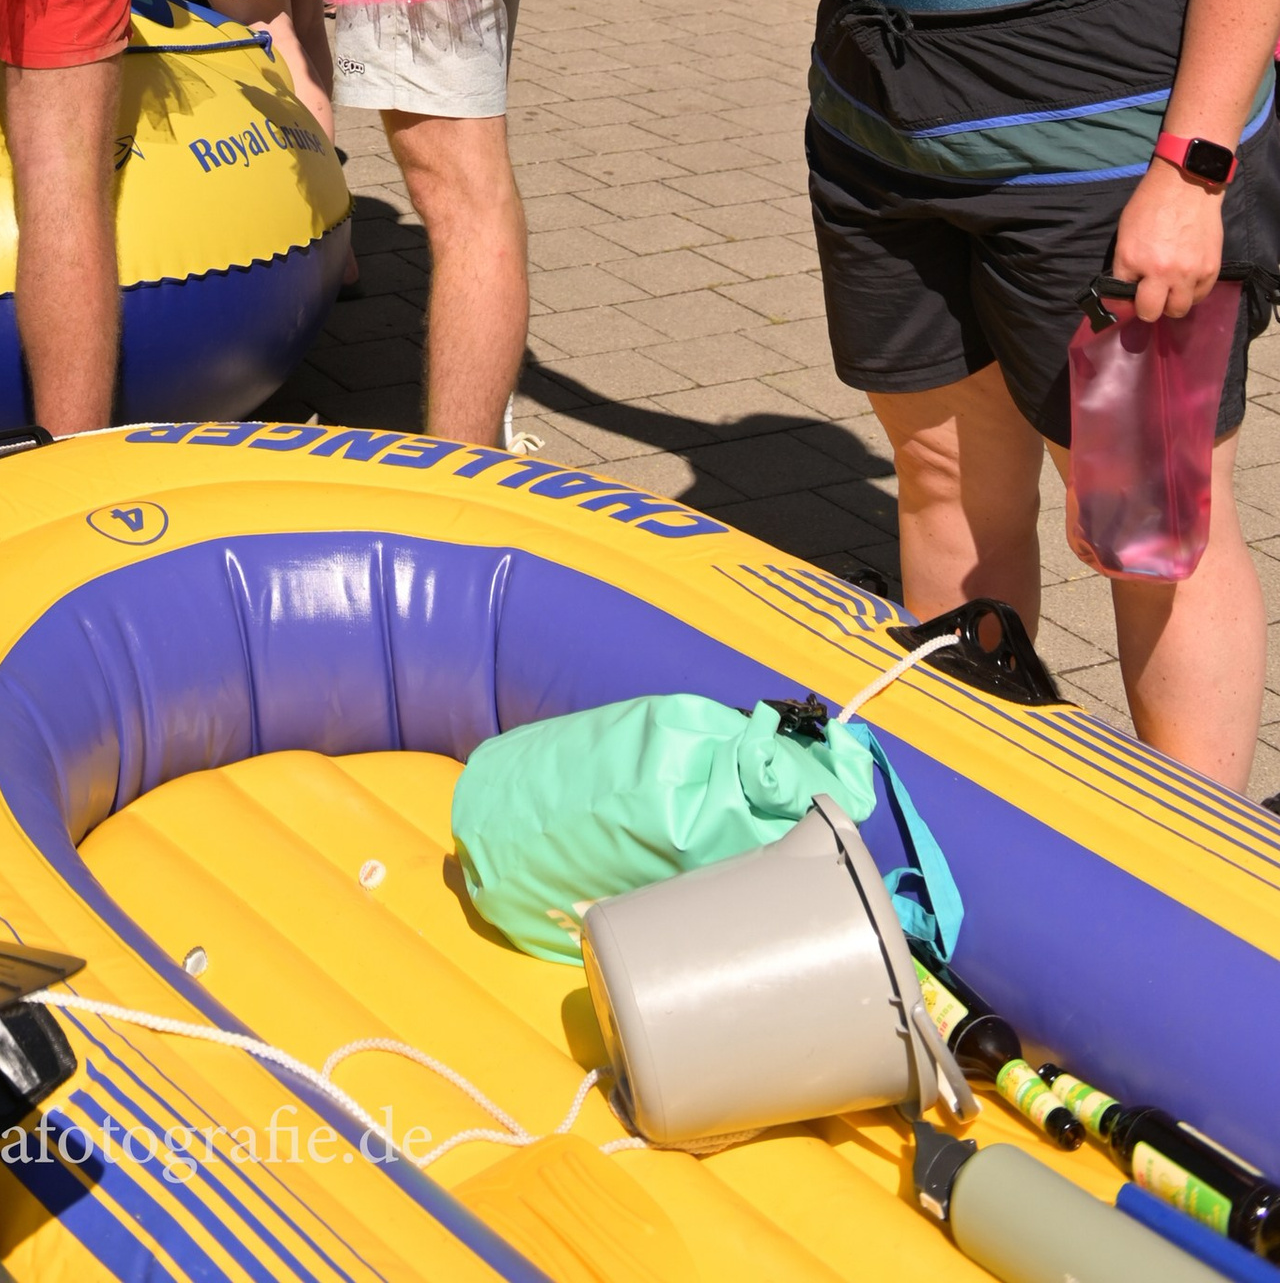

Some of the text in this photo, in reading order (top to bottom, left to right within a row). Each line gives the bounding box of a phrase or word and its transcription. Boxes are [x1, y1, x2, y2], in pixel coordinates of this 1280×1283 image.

[188, 117, 326, 173] Royal Cruise
[124, 421, 730, 538] CHALLENGER
[109, 507, 144, 533] 4
